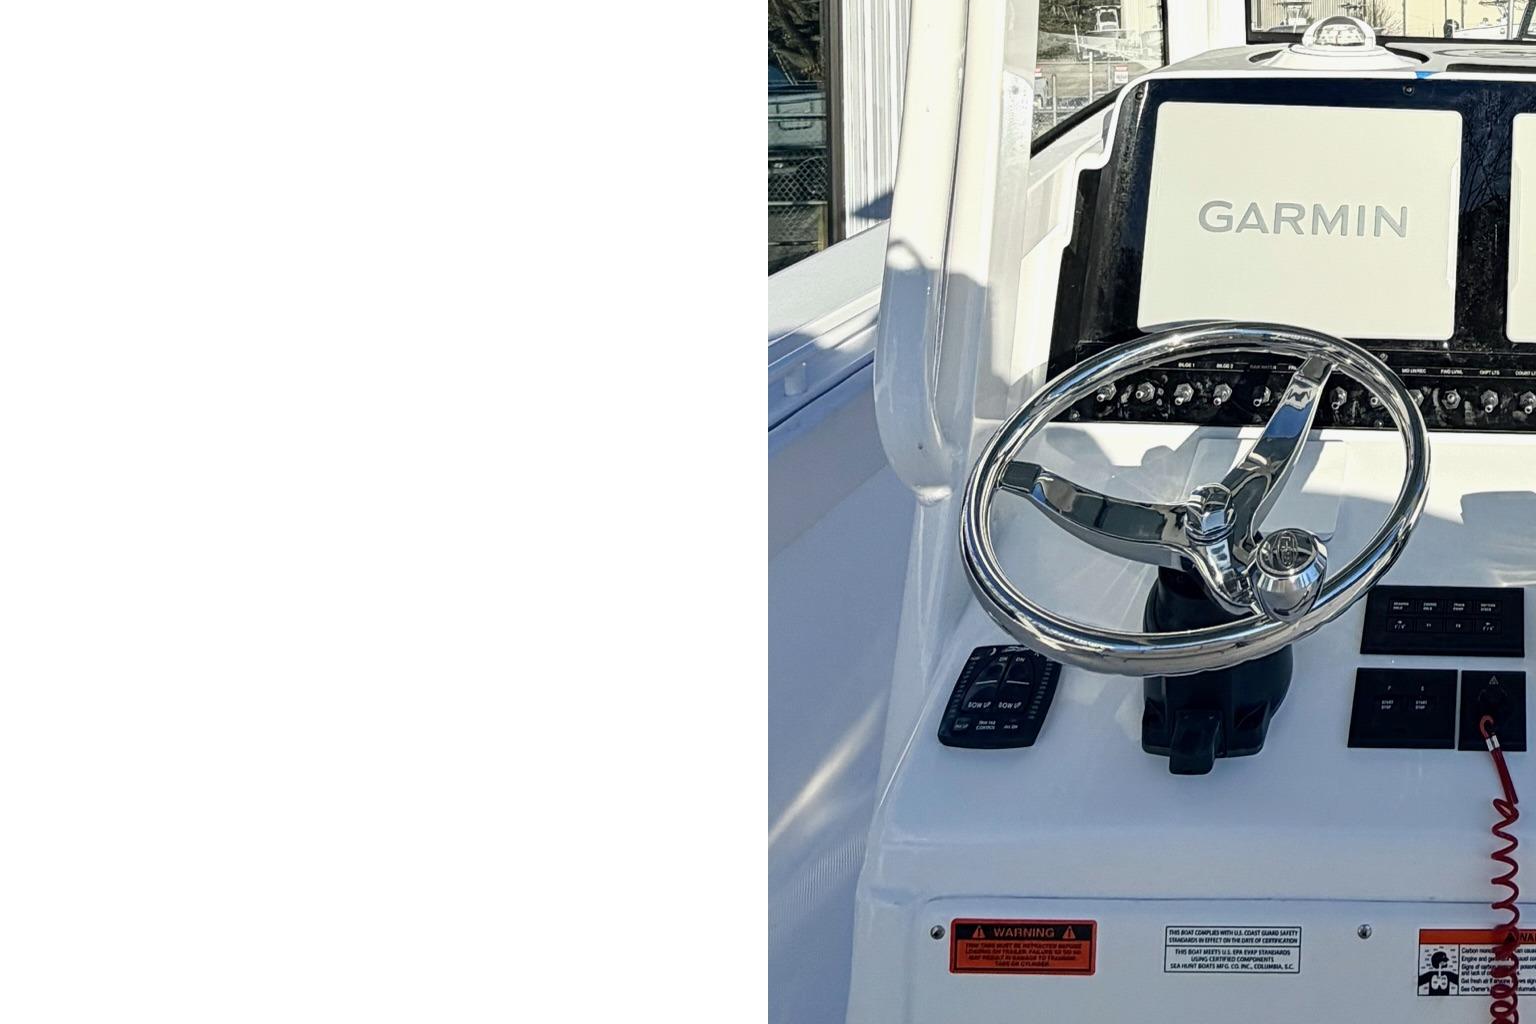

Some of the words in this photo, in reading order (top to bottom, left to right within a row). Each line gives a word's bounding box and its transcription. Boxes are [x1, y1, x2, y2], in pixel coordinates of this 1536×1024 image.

[1198, 200, 1408, 238] GARMIN
[968, 701, 982, 709] BOW
[993, 927, 1055, 938] WARNING
